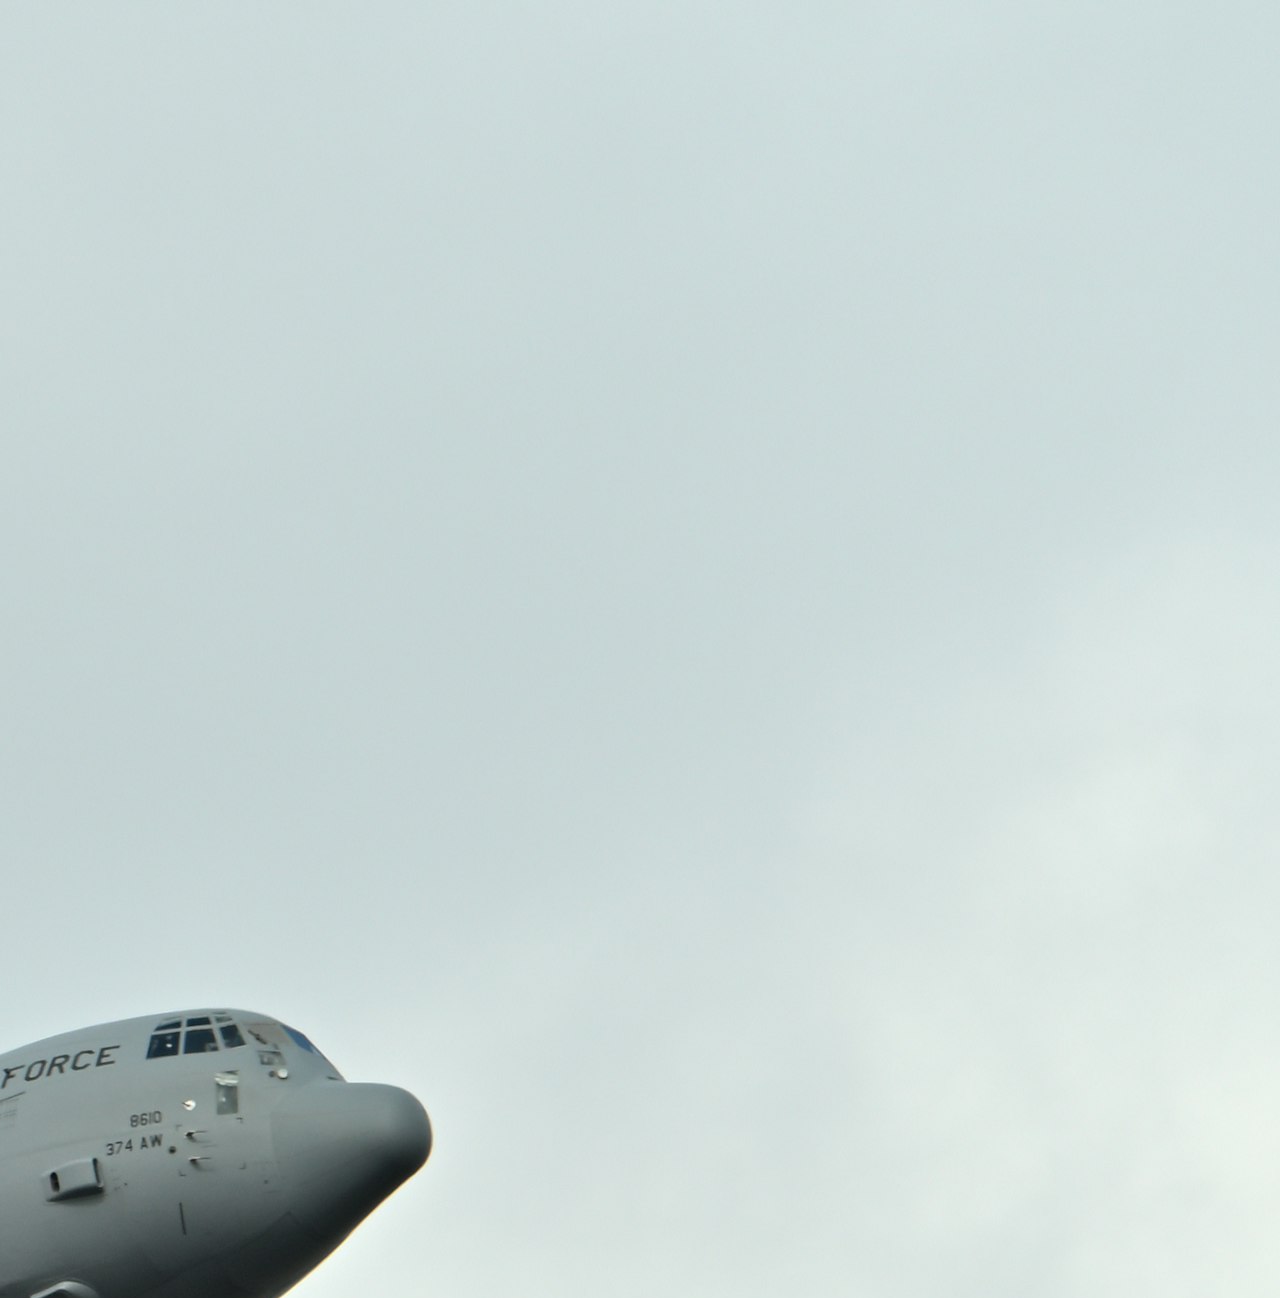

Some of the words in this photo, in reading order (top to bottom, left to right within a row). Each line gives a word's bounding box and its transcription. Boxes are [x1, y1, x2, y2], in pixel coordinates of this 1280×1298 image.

[0, 1045, 120, 1090] FORCE
[129, 1110, 163, 1128] 8610
[106, 1139, 134, 1156] 374
[140, 1133, 163, 1151] AW
